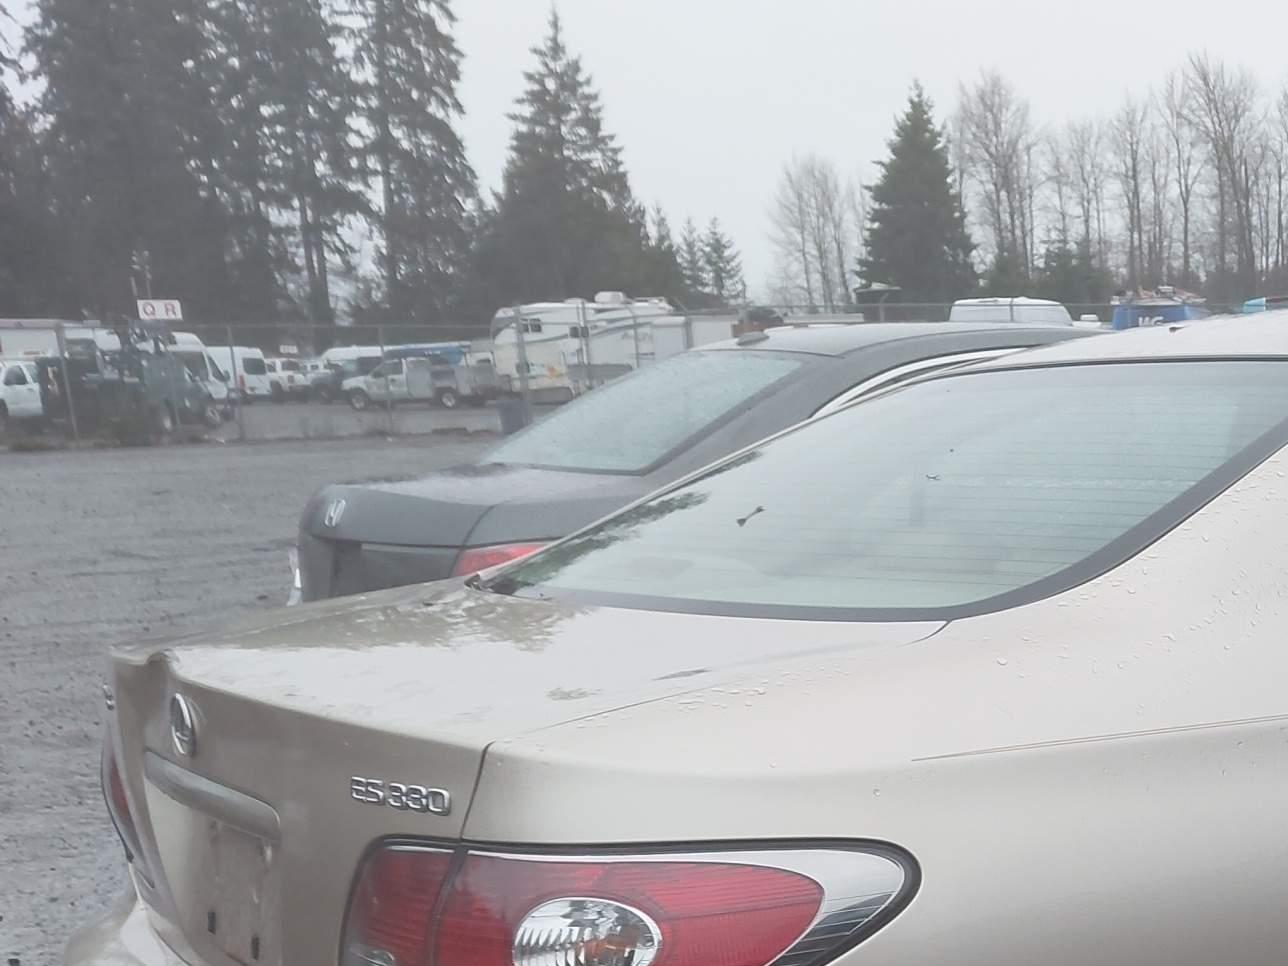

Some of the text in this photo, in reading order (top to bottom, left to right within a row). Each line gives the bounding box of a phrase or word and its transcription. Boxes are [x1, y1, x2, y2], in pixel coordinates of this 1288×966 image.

[142, 302, 177, 317] Q R
[351, 776, 451, 816] ES 330
